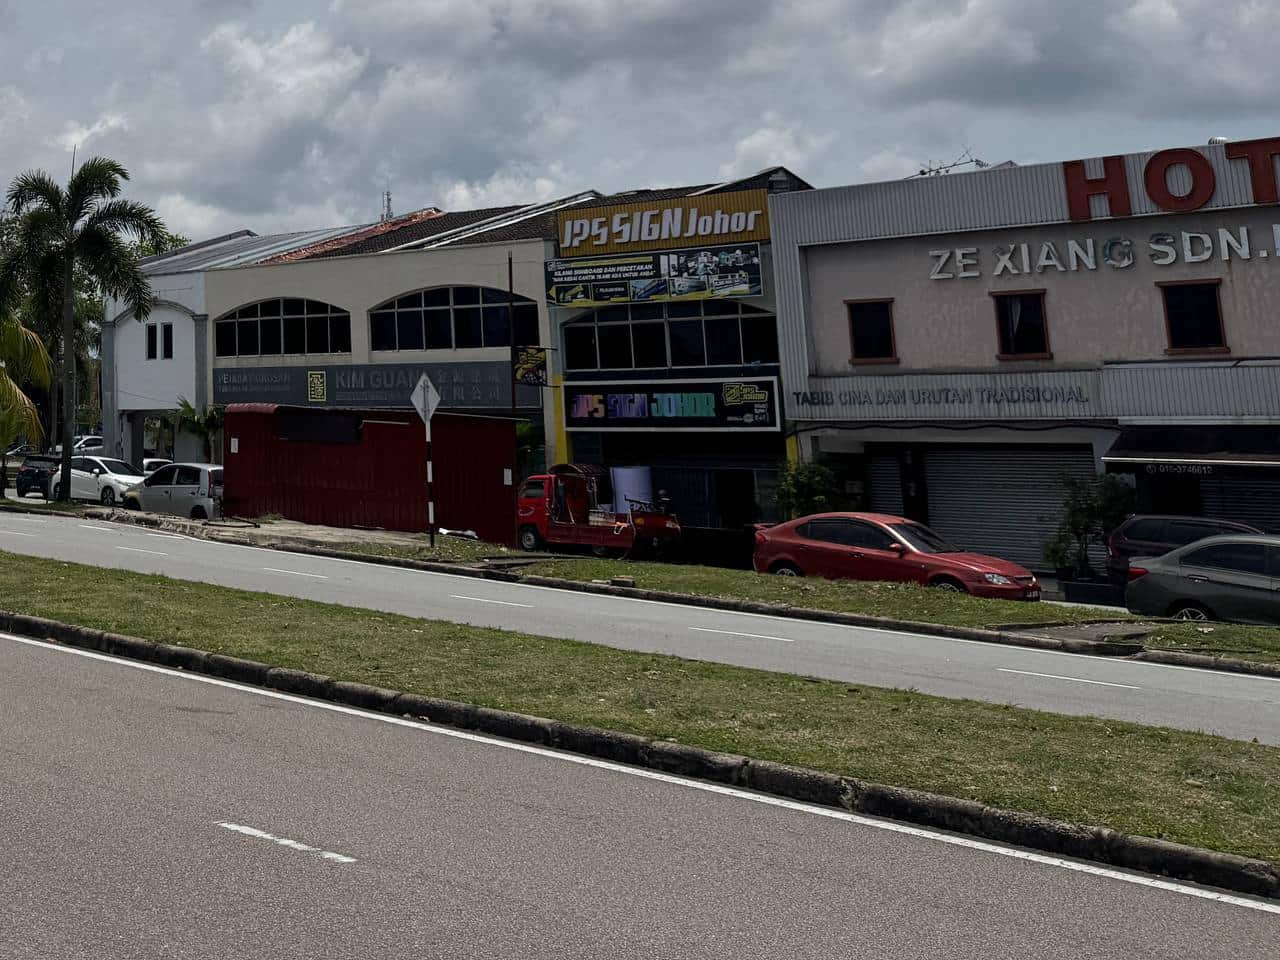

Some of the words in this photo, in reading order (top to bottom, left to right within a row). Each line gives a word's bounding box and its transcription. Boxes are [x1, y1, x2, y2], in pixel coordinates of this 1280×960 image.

[1062, 136, 1280, 221] HOT
[560, 218, 609, 248] JPS
[612, 208, 683, 244] SIGN
[683, 208, 763, 238] Johor
[928, 247, 982, 280] ZE
[992, 236, 1135, 276] XIANG
[1148, 225, 1280, 266] SDN.
[335, 370, 365, 389] KIM
[570, 393, 606, 418] JPS
[607, 393, 649, 418] SIGN
[650, 393, 717, 418] JOHOR
[792, 391, 834, 407] TABIB
[839, 390, 873, 406] CINA
[876, 389, 907, 406] DAN
[910, 388, 974, 406] URUTAN
[975, 385, 1089, 405] TRADISIONAL
